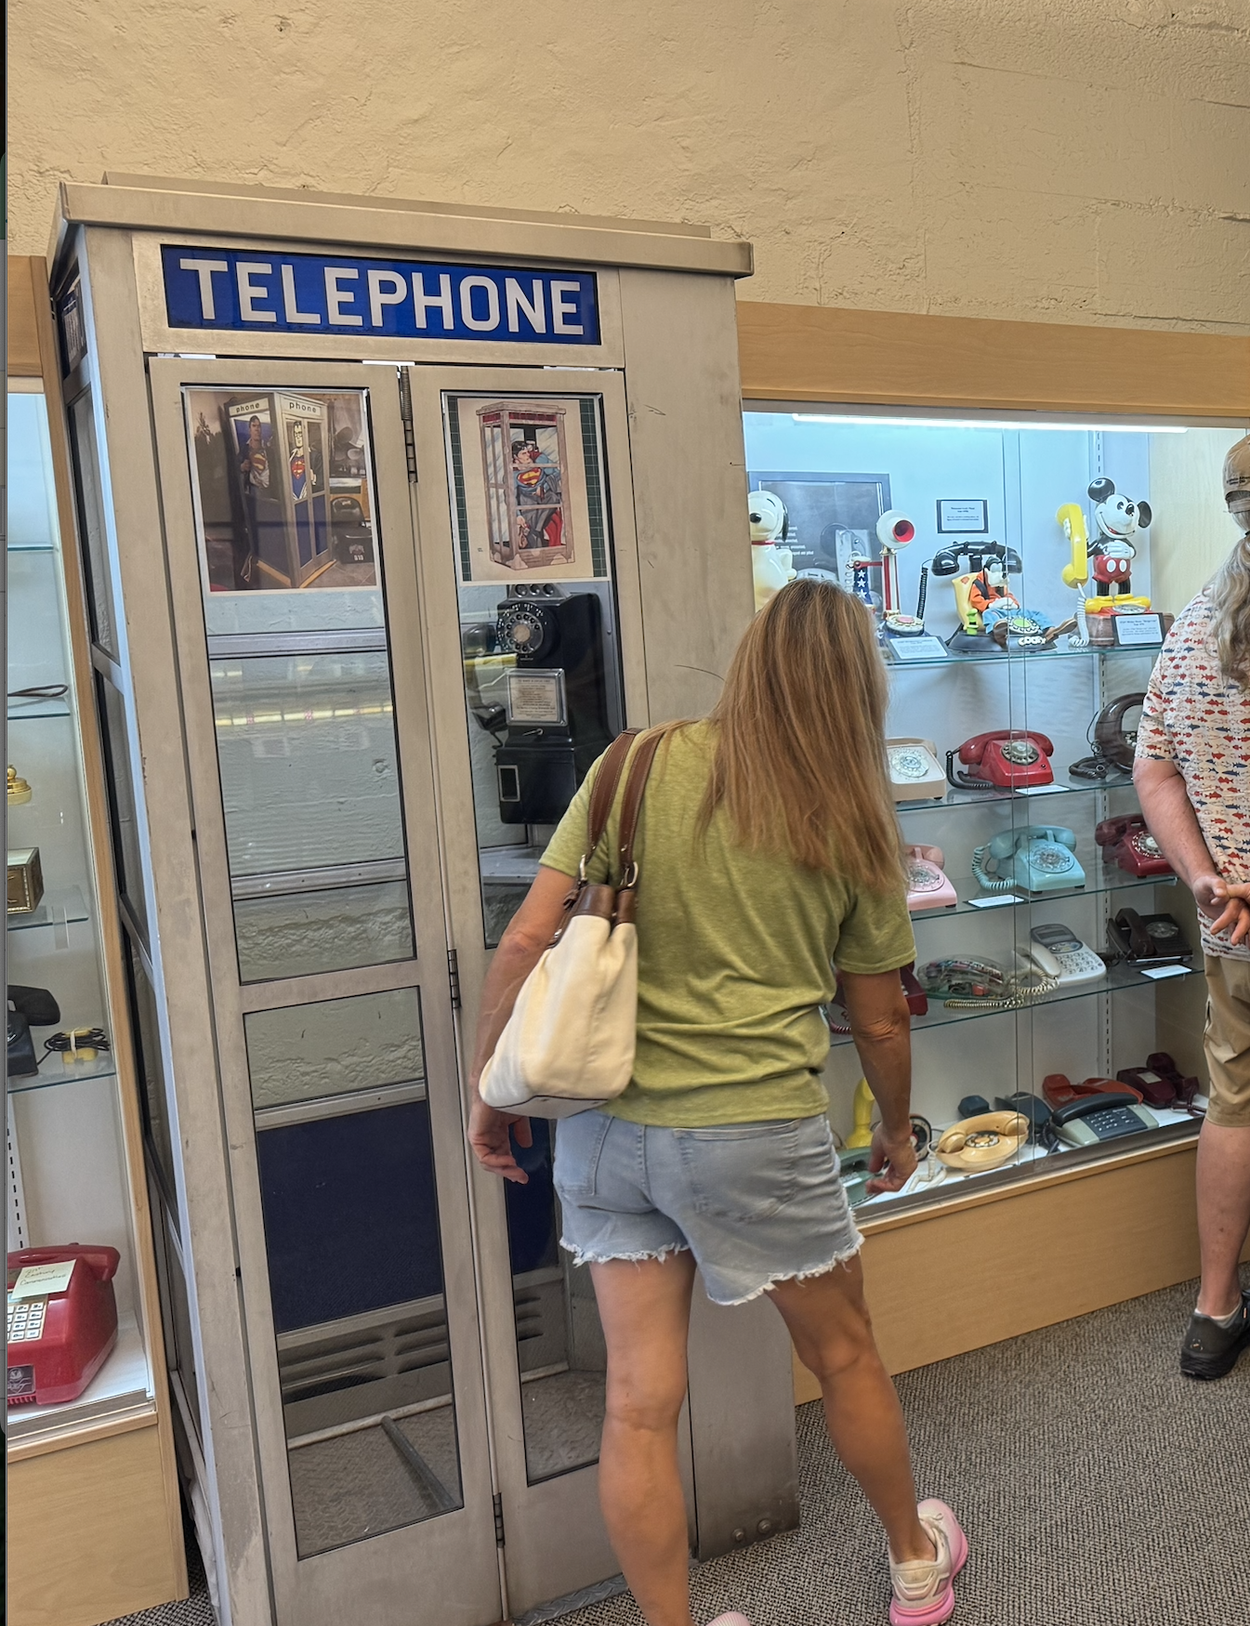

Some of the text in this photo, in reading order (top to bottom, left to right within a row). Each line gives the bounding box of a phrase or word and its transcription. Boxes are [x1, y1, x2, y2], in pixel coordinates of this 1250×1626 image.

[180, 258, 584, 336] TELEPHONE
[236, 402, 260, 414] phone
[289, 402, 317, 414] phone
